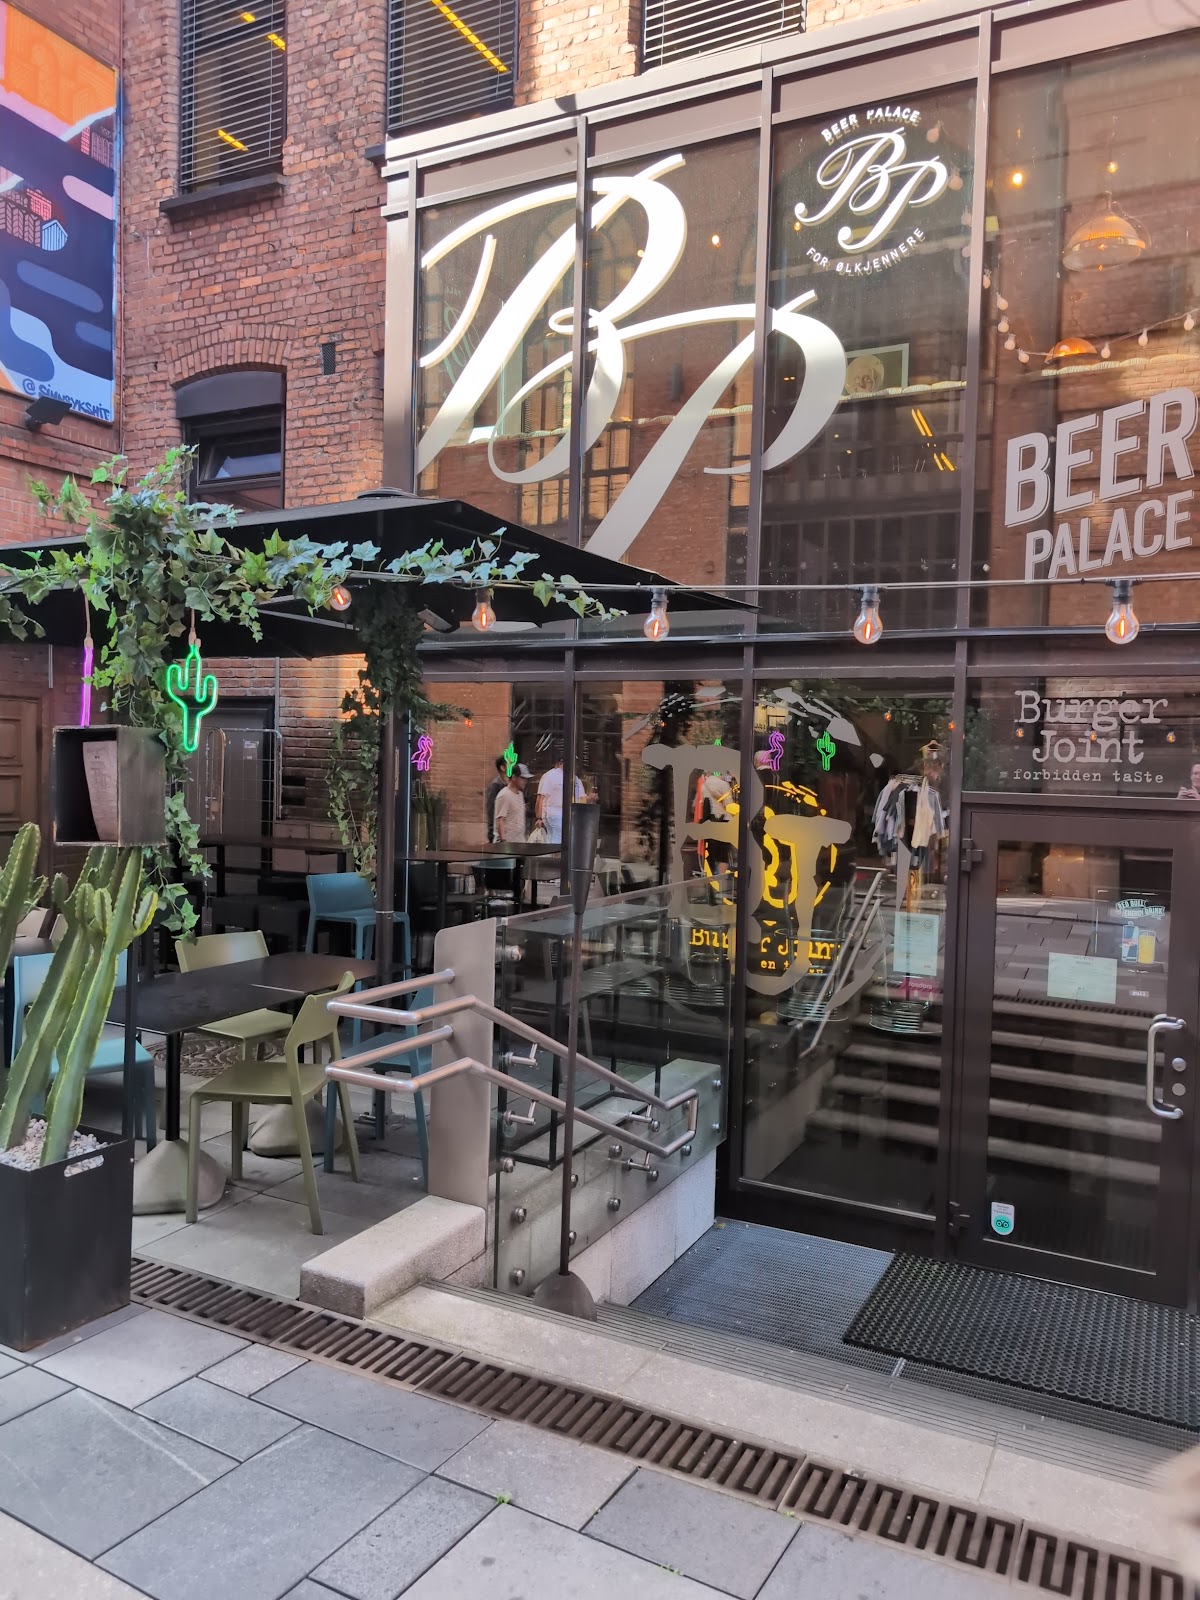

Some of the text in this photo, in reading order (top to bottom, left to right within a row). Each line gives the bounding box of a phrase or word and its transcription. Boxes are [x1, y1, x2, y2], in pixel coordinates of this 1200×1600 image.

[821, 106, 921, 142] BEER PALACE
[806, 227, 926, 273] FOR ØLKJENNERE
[1005, 388, 1198, 528] BEER
[1024, 489, 1195, 584] PALACE
[1013, 690, 1169, 732] Burger
[1032, 729, 1146, 765] Joint
[1013, 768, 1102, 782] forbidden
[908, 980, 933, 990] foodora
